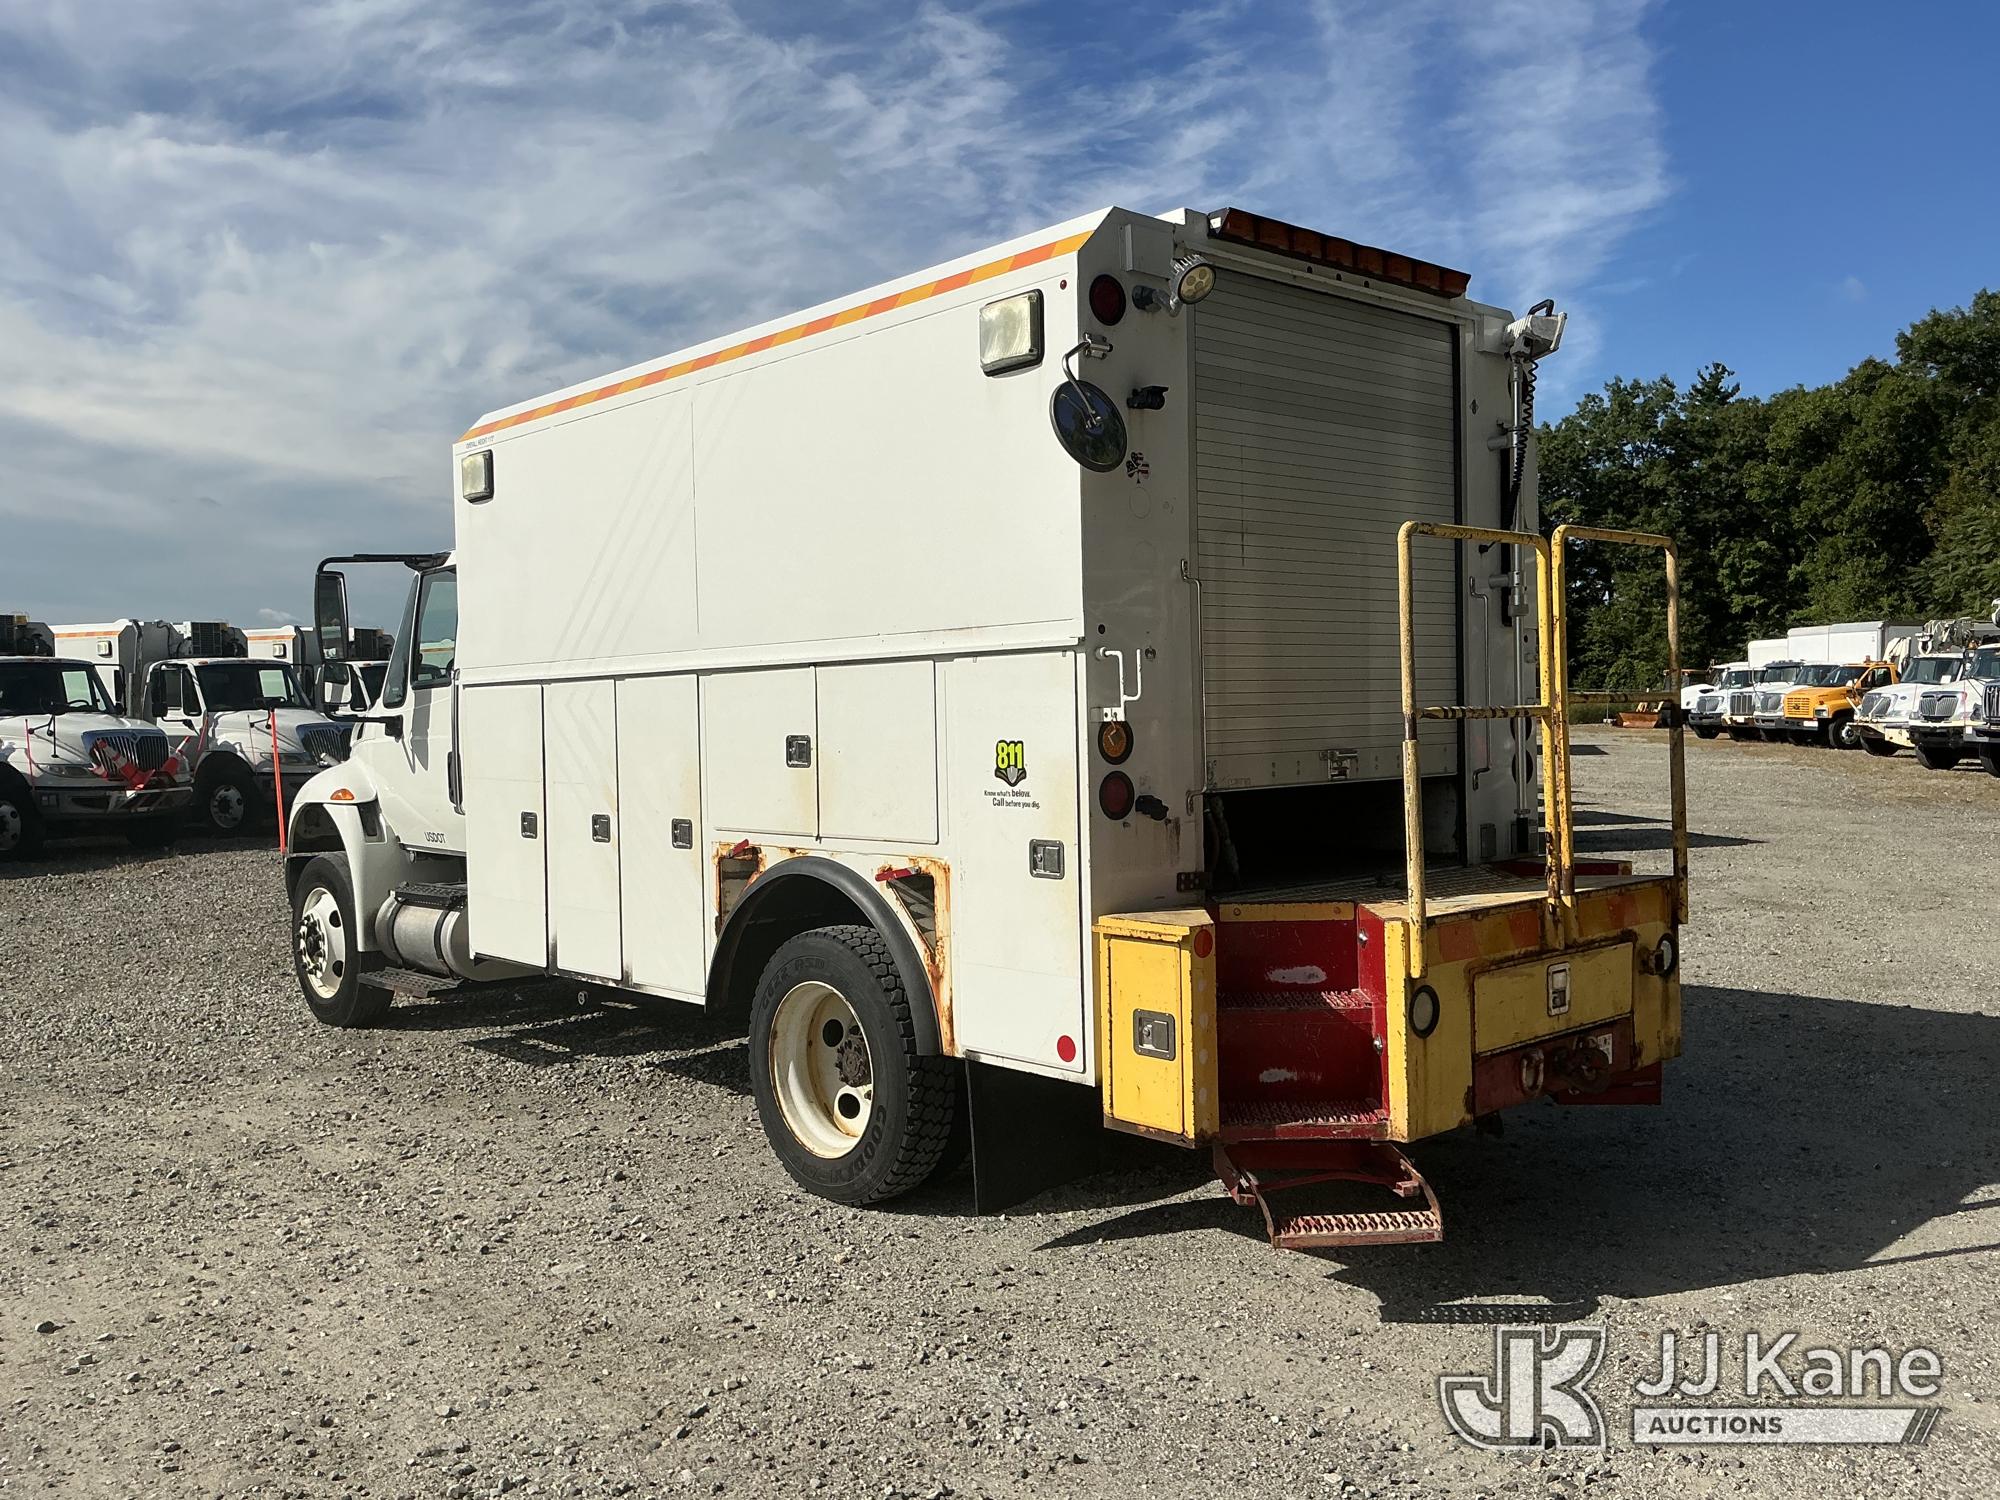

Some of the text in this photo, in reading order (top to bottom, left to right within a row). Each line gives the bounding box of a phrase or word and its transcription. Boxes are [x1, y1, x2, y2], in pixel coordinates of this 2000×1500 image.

[996, 740, 1024, 769] 811
[1011, 789, 1031, 797] below.
[992, 797, 1041, 810] Call before you dig.
[424, 831, 446, 843] USDOT
